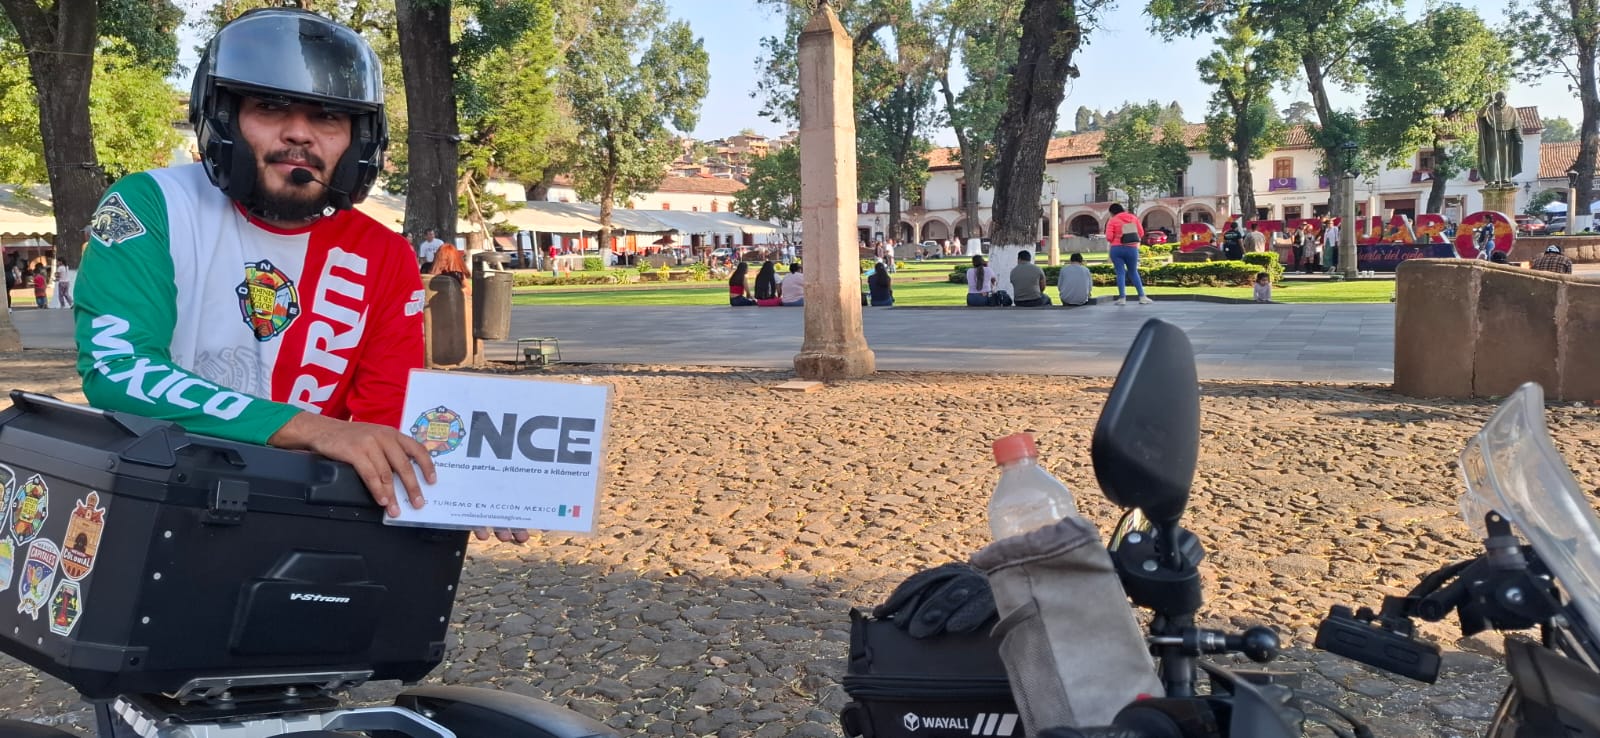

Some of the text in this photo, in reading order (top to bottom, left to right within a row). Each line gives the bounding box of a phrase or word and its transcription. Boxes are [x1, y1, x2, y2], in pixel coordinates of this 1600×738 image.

[91, 314, 254, 420] MXICO
[434, 461, 470, 470] haciendo
[550, 468, 590, 477] kilómetro!
[433, 500, 472, 508] TURISMO
[489, 502, 521, 511] ACCIÓN
[30, 547, 57, 566] CAPITALES
[63, 547, 92, 567] COLONIAL
[290, 593, 350, 603] V-Strom
[922, 716, 969, 730] WAYALI
